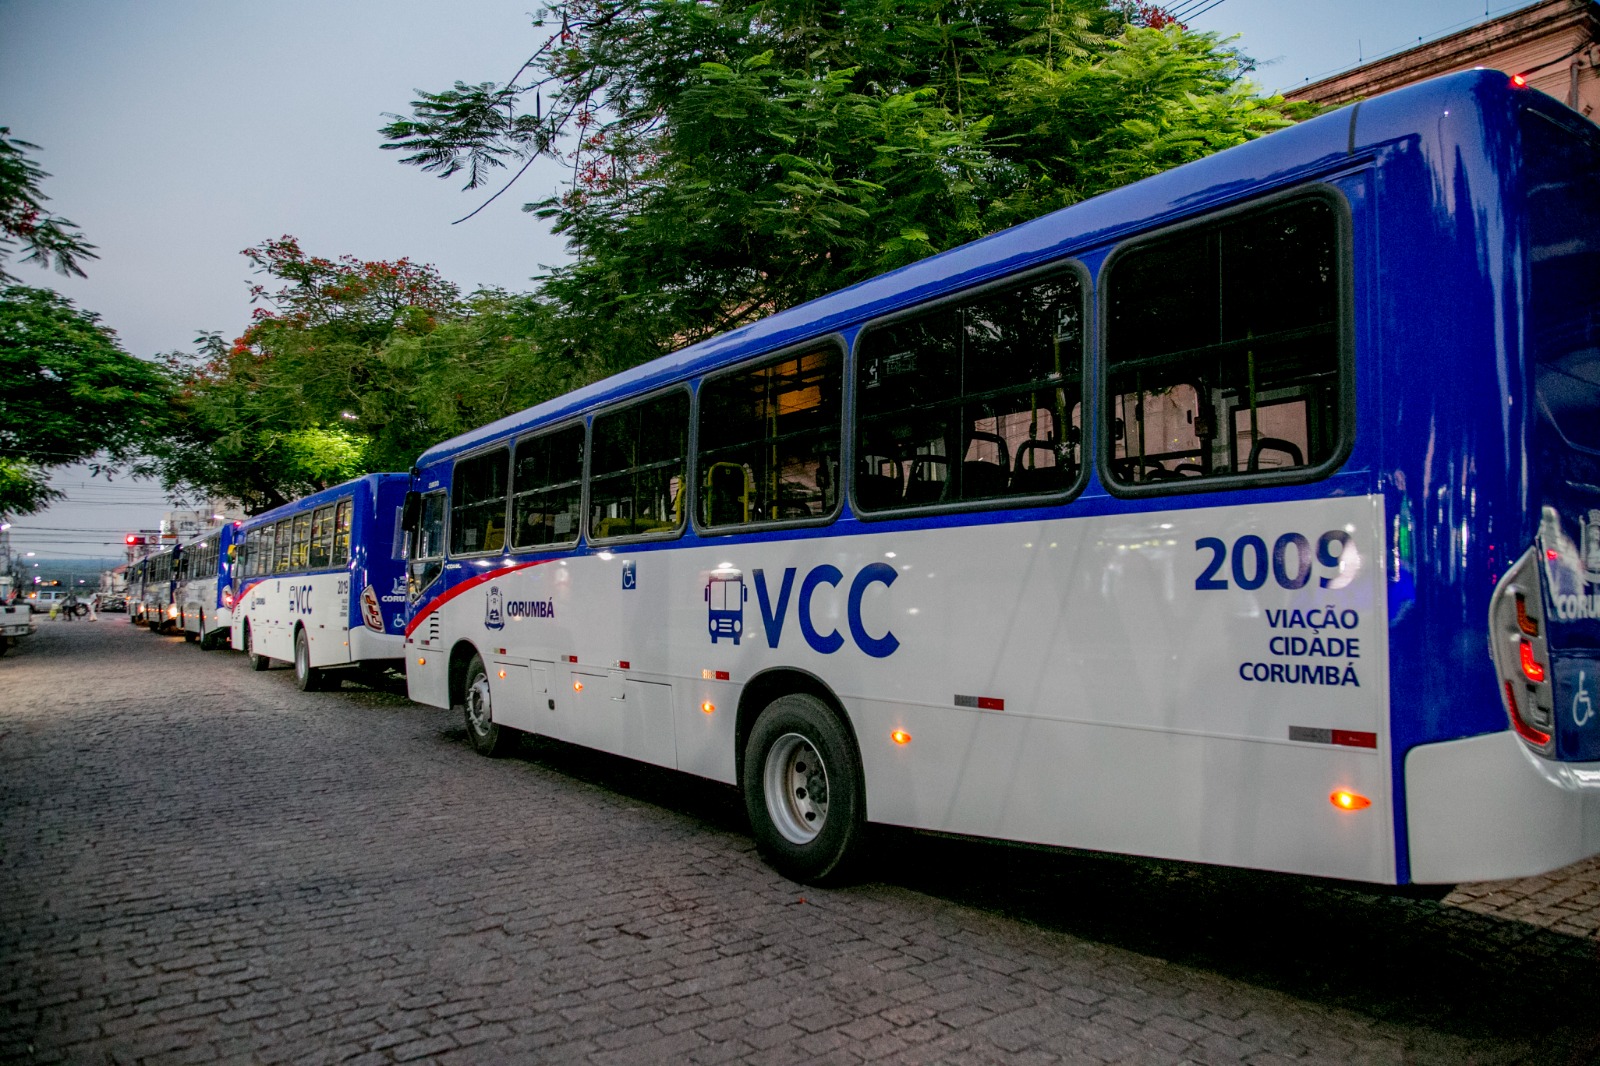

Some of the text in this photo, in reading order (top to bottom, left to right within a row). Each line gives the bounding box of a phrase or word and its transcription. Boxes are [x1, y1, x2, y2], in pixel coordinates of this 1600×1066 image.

[1195, 530, 1361, 590] 2009
[296, 585, 312, 614] VCC
[507, 597, 554, 618] CORUMBÁ
[752, 562, 900, 658] VCC
[1557, 594, 1600, 619] CORU
[1265, 604, 1359, 634] VIAÇÃO
[1269, 636, 1361, 658] CIDADE
[1239, 661, 1361, 687] CORUMBÁ
